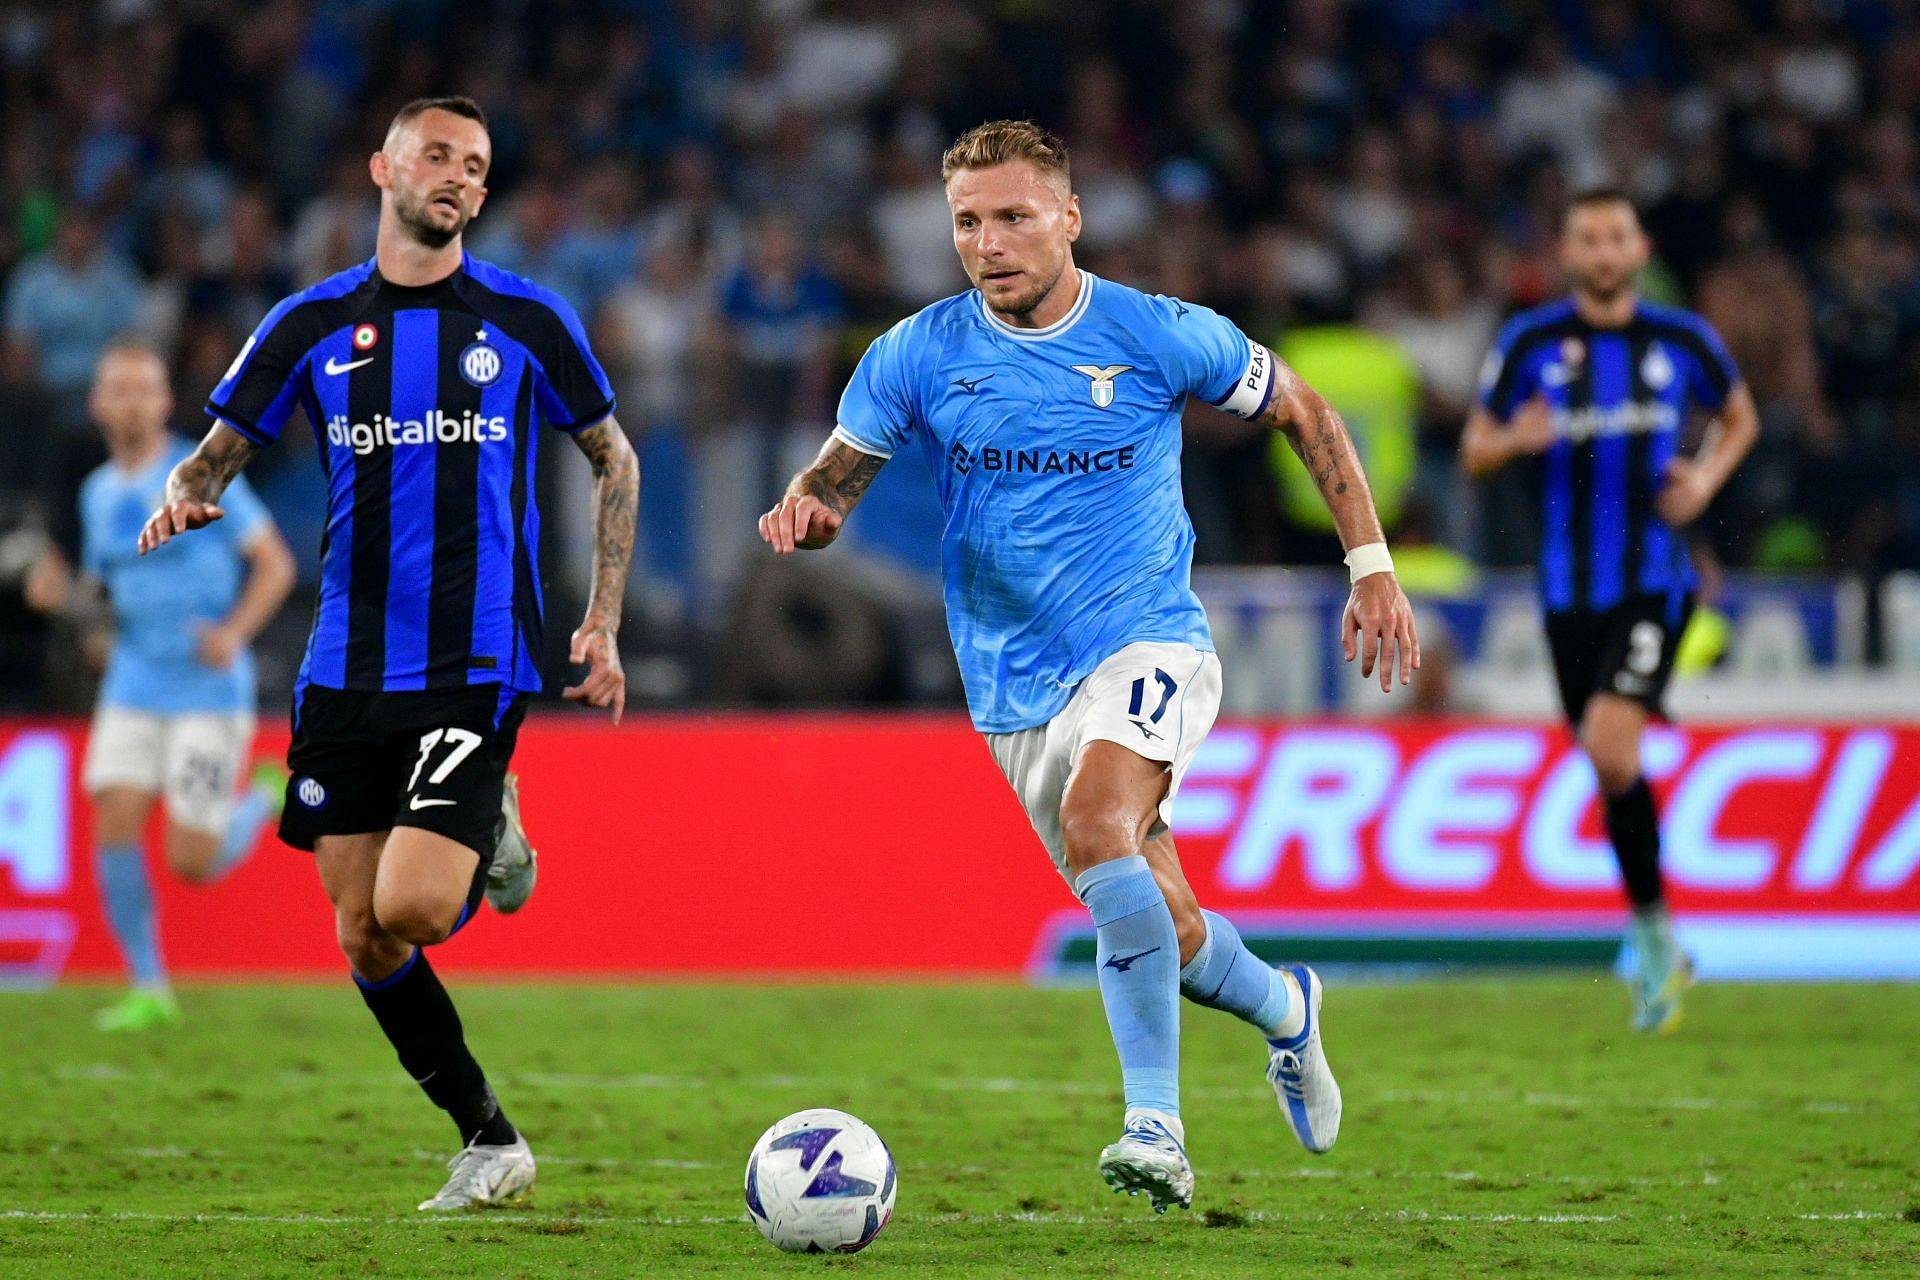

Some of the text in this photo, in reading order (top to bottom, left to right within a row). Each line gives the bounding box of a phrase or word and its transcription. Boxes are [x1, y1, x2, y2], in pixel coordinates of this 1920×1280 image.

[1247, 341, 1264, 390] PEAC
[327, 410, 507, 455] digitalbits
[983, 445, 1136, 474] BINANCE
[1128, 667, 1177, 725] 17
